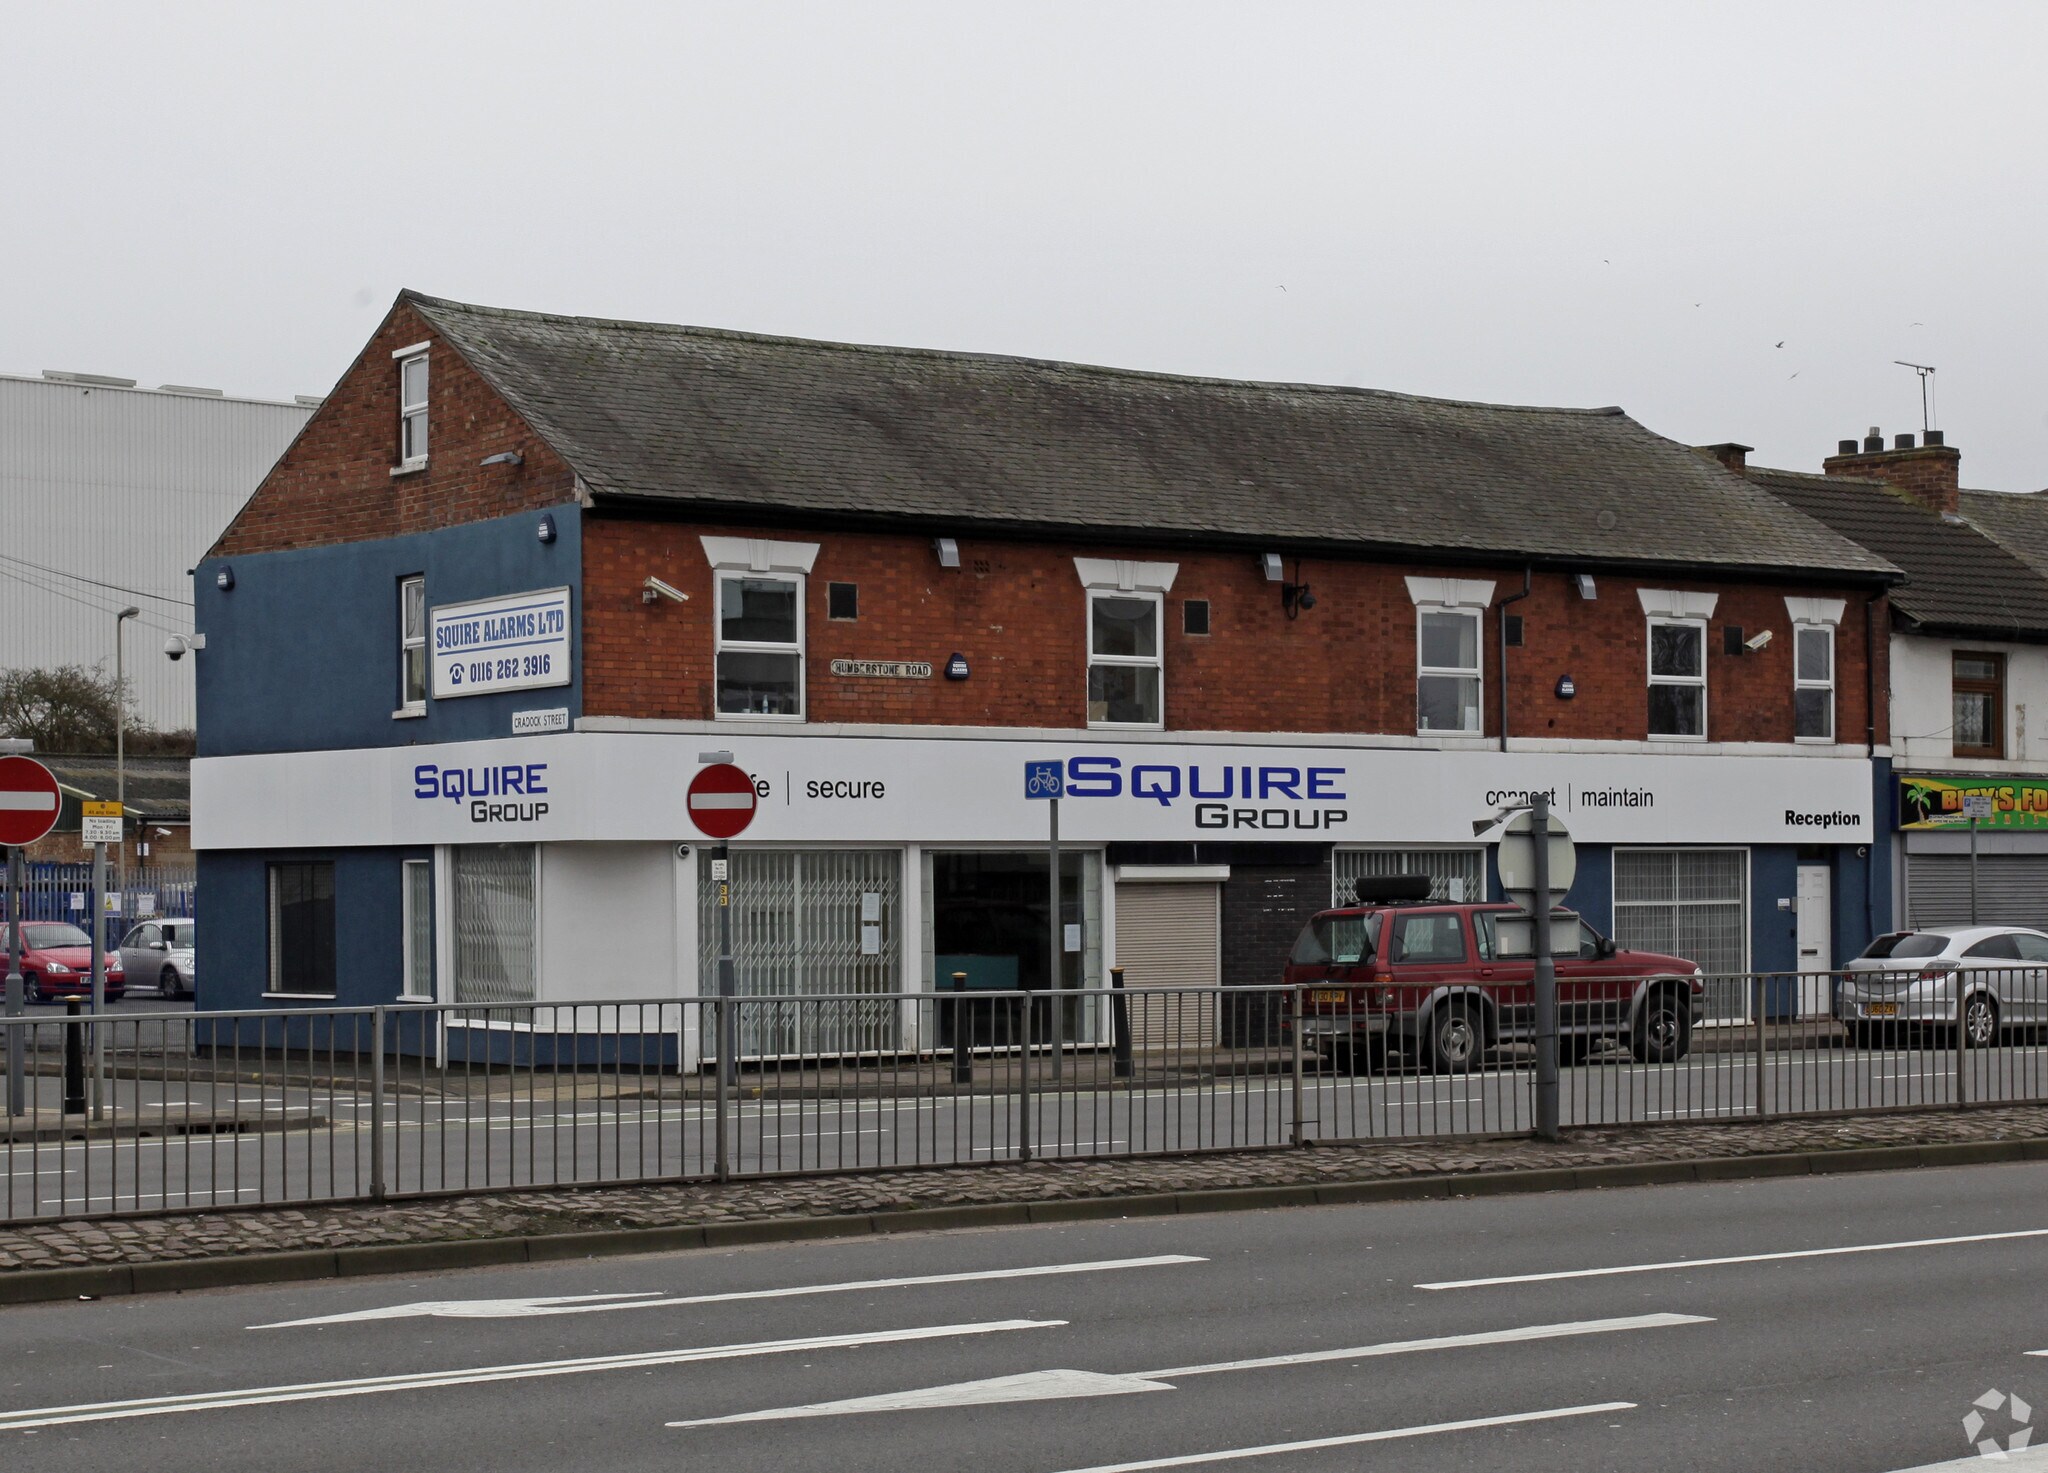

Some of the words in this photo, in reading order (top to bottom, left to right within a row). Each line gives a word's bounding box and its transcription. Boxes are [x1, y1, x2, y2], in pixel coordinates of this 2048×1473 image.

[436, 621, 480, 649] SQUIRE
[484, 613, 535, 642] ALARMS
[538, 609, 564, 634] LTD
[470, 661, 493, 683] 0116
[497, 657, 519, 680] 262
[523, 653, 551, 677] 3916
[836, 661, 900, 675] HUMBERSTONE
[905, 664, 929, 676] ROAD
[514, 716, 542, 728] CRADOCK
[543, 713, 566, 726] STREET
[414, 763, 548, 805] SQUIRE
[806, 779, 886, 799] secure
[1065, 756, 1347, 807] SQUIRE
[1581, 786, 1654, 807] maintain
[470, 800, 550, 823] GROUP
[1194, 803, 1348, 830] GROUP
[1785, 810, 1861, 830] Reception
